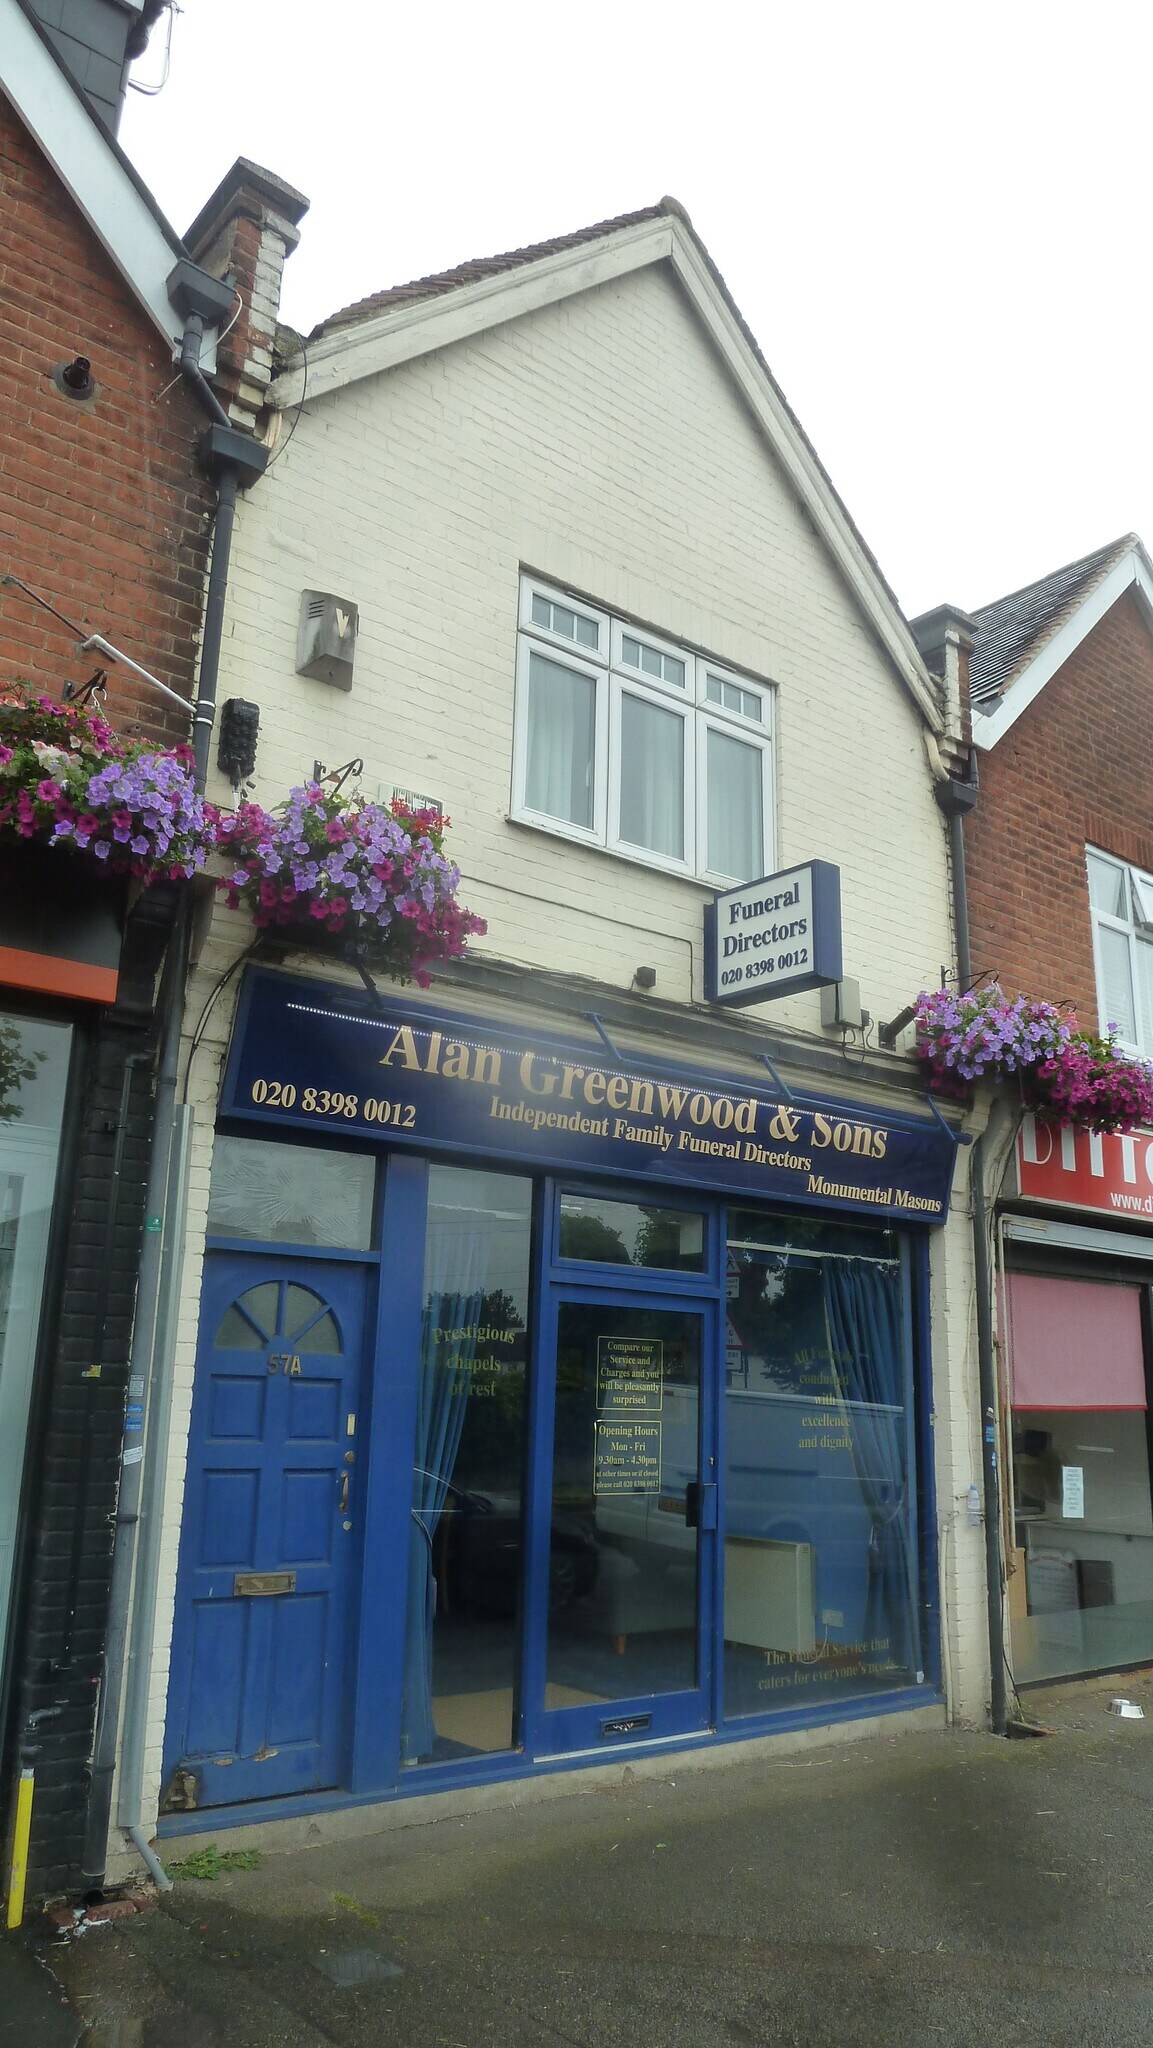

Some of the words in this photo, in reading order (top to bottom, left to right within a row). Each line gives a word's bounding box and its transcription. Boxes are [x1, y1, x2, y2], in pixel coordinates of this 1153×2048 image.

[729, 882, 800, 924] Funeral
[722, 918, 807, 957] Directors
[721, 967, 742, 985] 020
[745, 957, 775, 979] 8398
[777, 948, 808, 969] 0012
[379, 1025, 500, 1085] Alan
[520, 1050, 757, 1134] Greenwood
[769, 1104, 801, 1142] &
[811, 1112, 888, 1159] Sons
[252, 1079, 297, 1108] 020
[301, 1087, 357, 1118] 8398
[363, 1098, 416, 1128] 0012
[489, 1095, 608, 1138] Independent
[612, 1118, 674, 1151] Family
[677, 1131, 742, 1160] Funeral
[743, 1143, 812, 1172] Directors
[807, 1174, 892, 1206] Monumental
[894, 1189, 941, 1213] Masons
[432, 1323, 516, 1345] Prestigious
[607, 1340, 640, 1353] Compare
[641, 1344, 654, 1353] our
[267, 1354, 302, 1376] 57A
[446, 1354, 501, 1374] chapels
[609, 1353, 636, 1365] Service
[637, 1356, 651, 1365] and
[600, 1367, 630, 1379] Charges
[631, 1369, 645, 1379] and
[646, 1371, 660, 1380] you
[469, 1381, 497, 1396] rest
[599, 1380, 613, 1390] will
[614, 1380, 623, 1391] be
[624, 1381, 659, 1393] pleasantly
[612, 1395, 647, 1406] surprised
[815, 1393, 836, 1406] with
[802, 1413, 851, 1427] excellence
[599, 1425, 632, 1438] Opening
[634, 1425, 658, 1436] Hours
[611, 1441, 628, 1451] Mon
[634, 1441, 646, 1451] Fri
[798, 1435, 818, 1448] and
[820, 1435, 853, 1450] dignity
[598, 1455, 625, 1465] 9.30am
[631, 1455, 657, 1467] 4.30pm
[764, 1651, 786, 1666] The
[832, 1639, 868, 1656] Service
[871, 1637, 890, 1651] that
[794, 1671, 809, 1686] for
